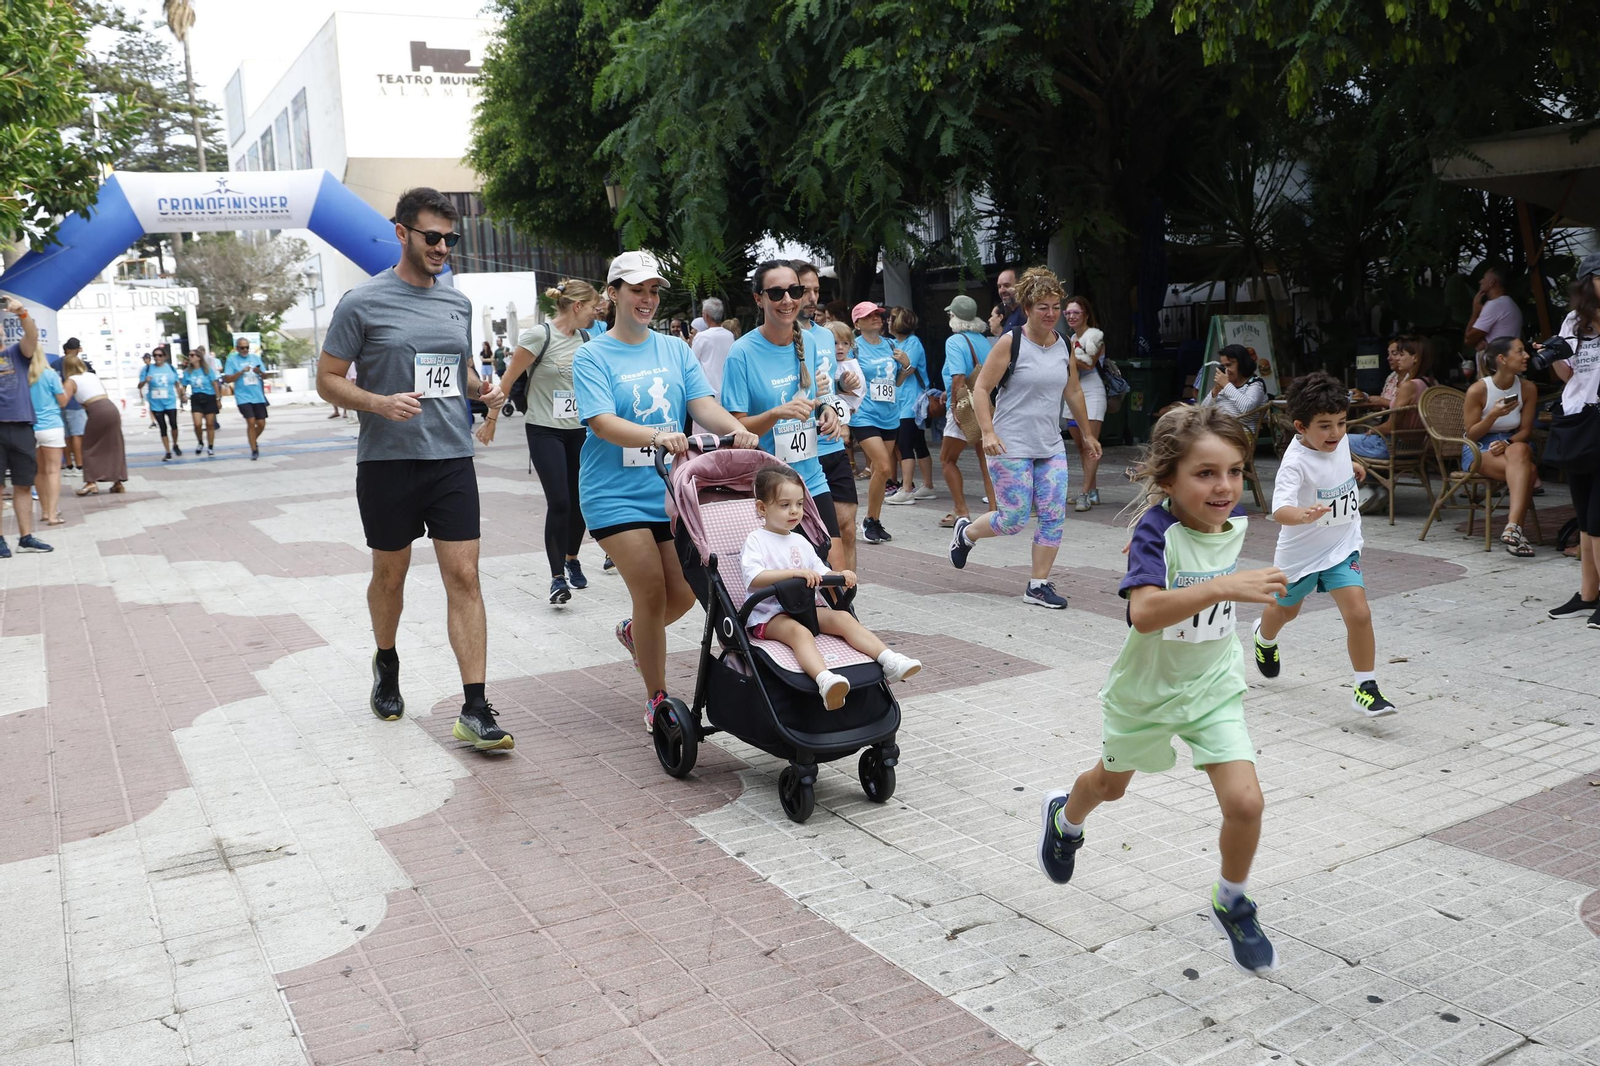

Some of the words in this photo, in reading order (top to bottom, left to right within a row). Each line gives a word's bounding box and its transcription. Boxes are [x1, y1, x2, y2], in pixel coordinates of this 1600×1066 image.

[377, 74, 433, 85] TEATRO
[157, 196, 290, 215] CRONOFINISHER
[128, 290, 197, 307] TURISMO
[426, 366, 450, 388] 142
[621, 369, 652, 380] Desafío
[652, 366, 669, 374] ELA
[770, 374, 797, 386] Desafío
[876, 384, 893, 397] 189
[790, 431, 807, 453] 40
[1329, 490, 1358, 518] 173
